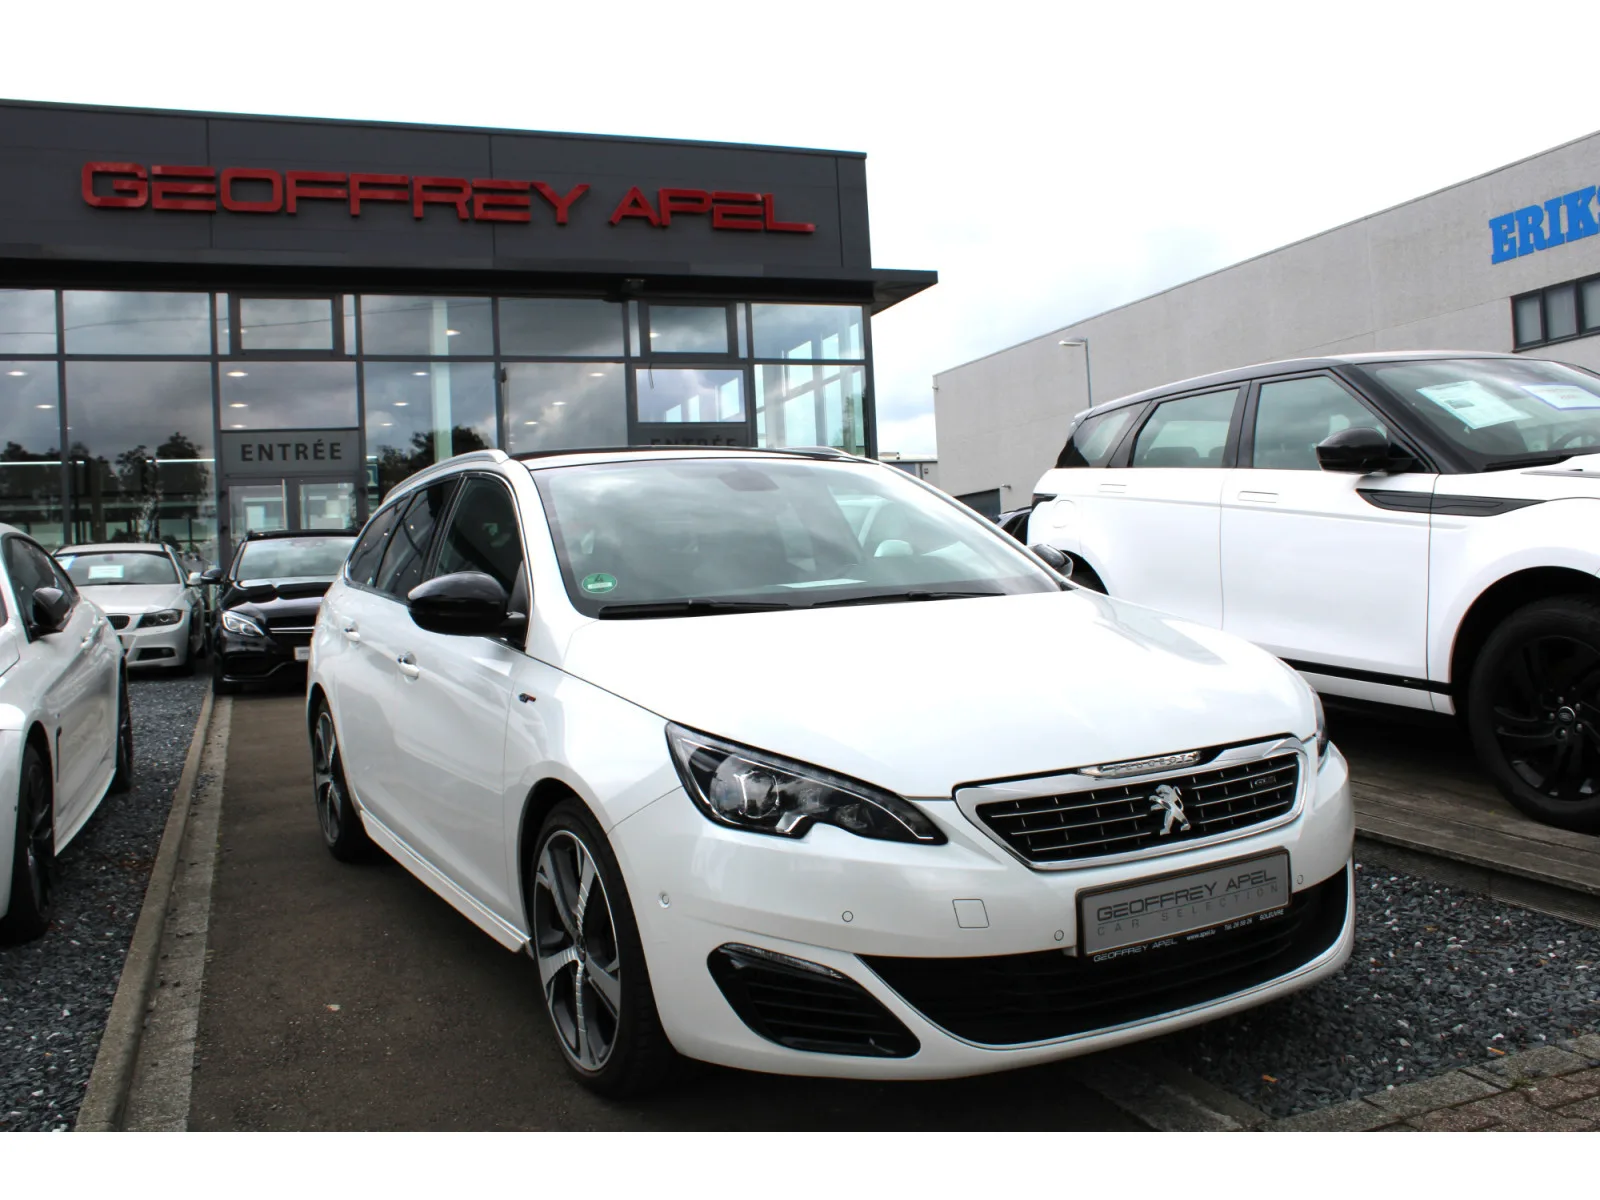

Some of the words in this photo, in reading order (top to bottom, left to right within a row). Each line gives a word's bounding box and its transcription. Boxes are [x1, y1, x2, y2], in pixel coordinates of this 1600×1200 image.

[82, 162, 591, 225] GEOFFREY
[609, 186, 816, 232] APEL
[1489, 184, 1600, 265] ERIK
[241, 439, 342, 461] ENTRÉE
[1097, 881, 1218, 922] GEOFFREY
[1225, 870, 1277, 892] APEL
[1097, 918, 1140, 937] CAR
[1161, 883, 1279, 922] SELECTION
[1094, 944, 1149, 962] GEOFFREY
[1152, 938, 1179, 950] APEL
